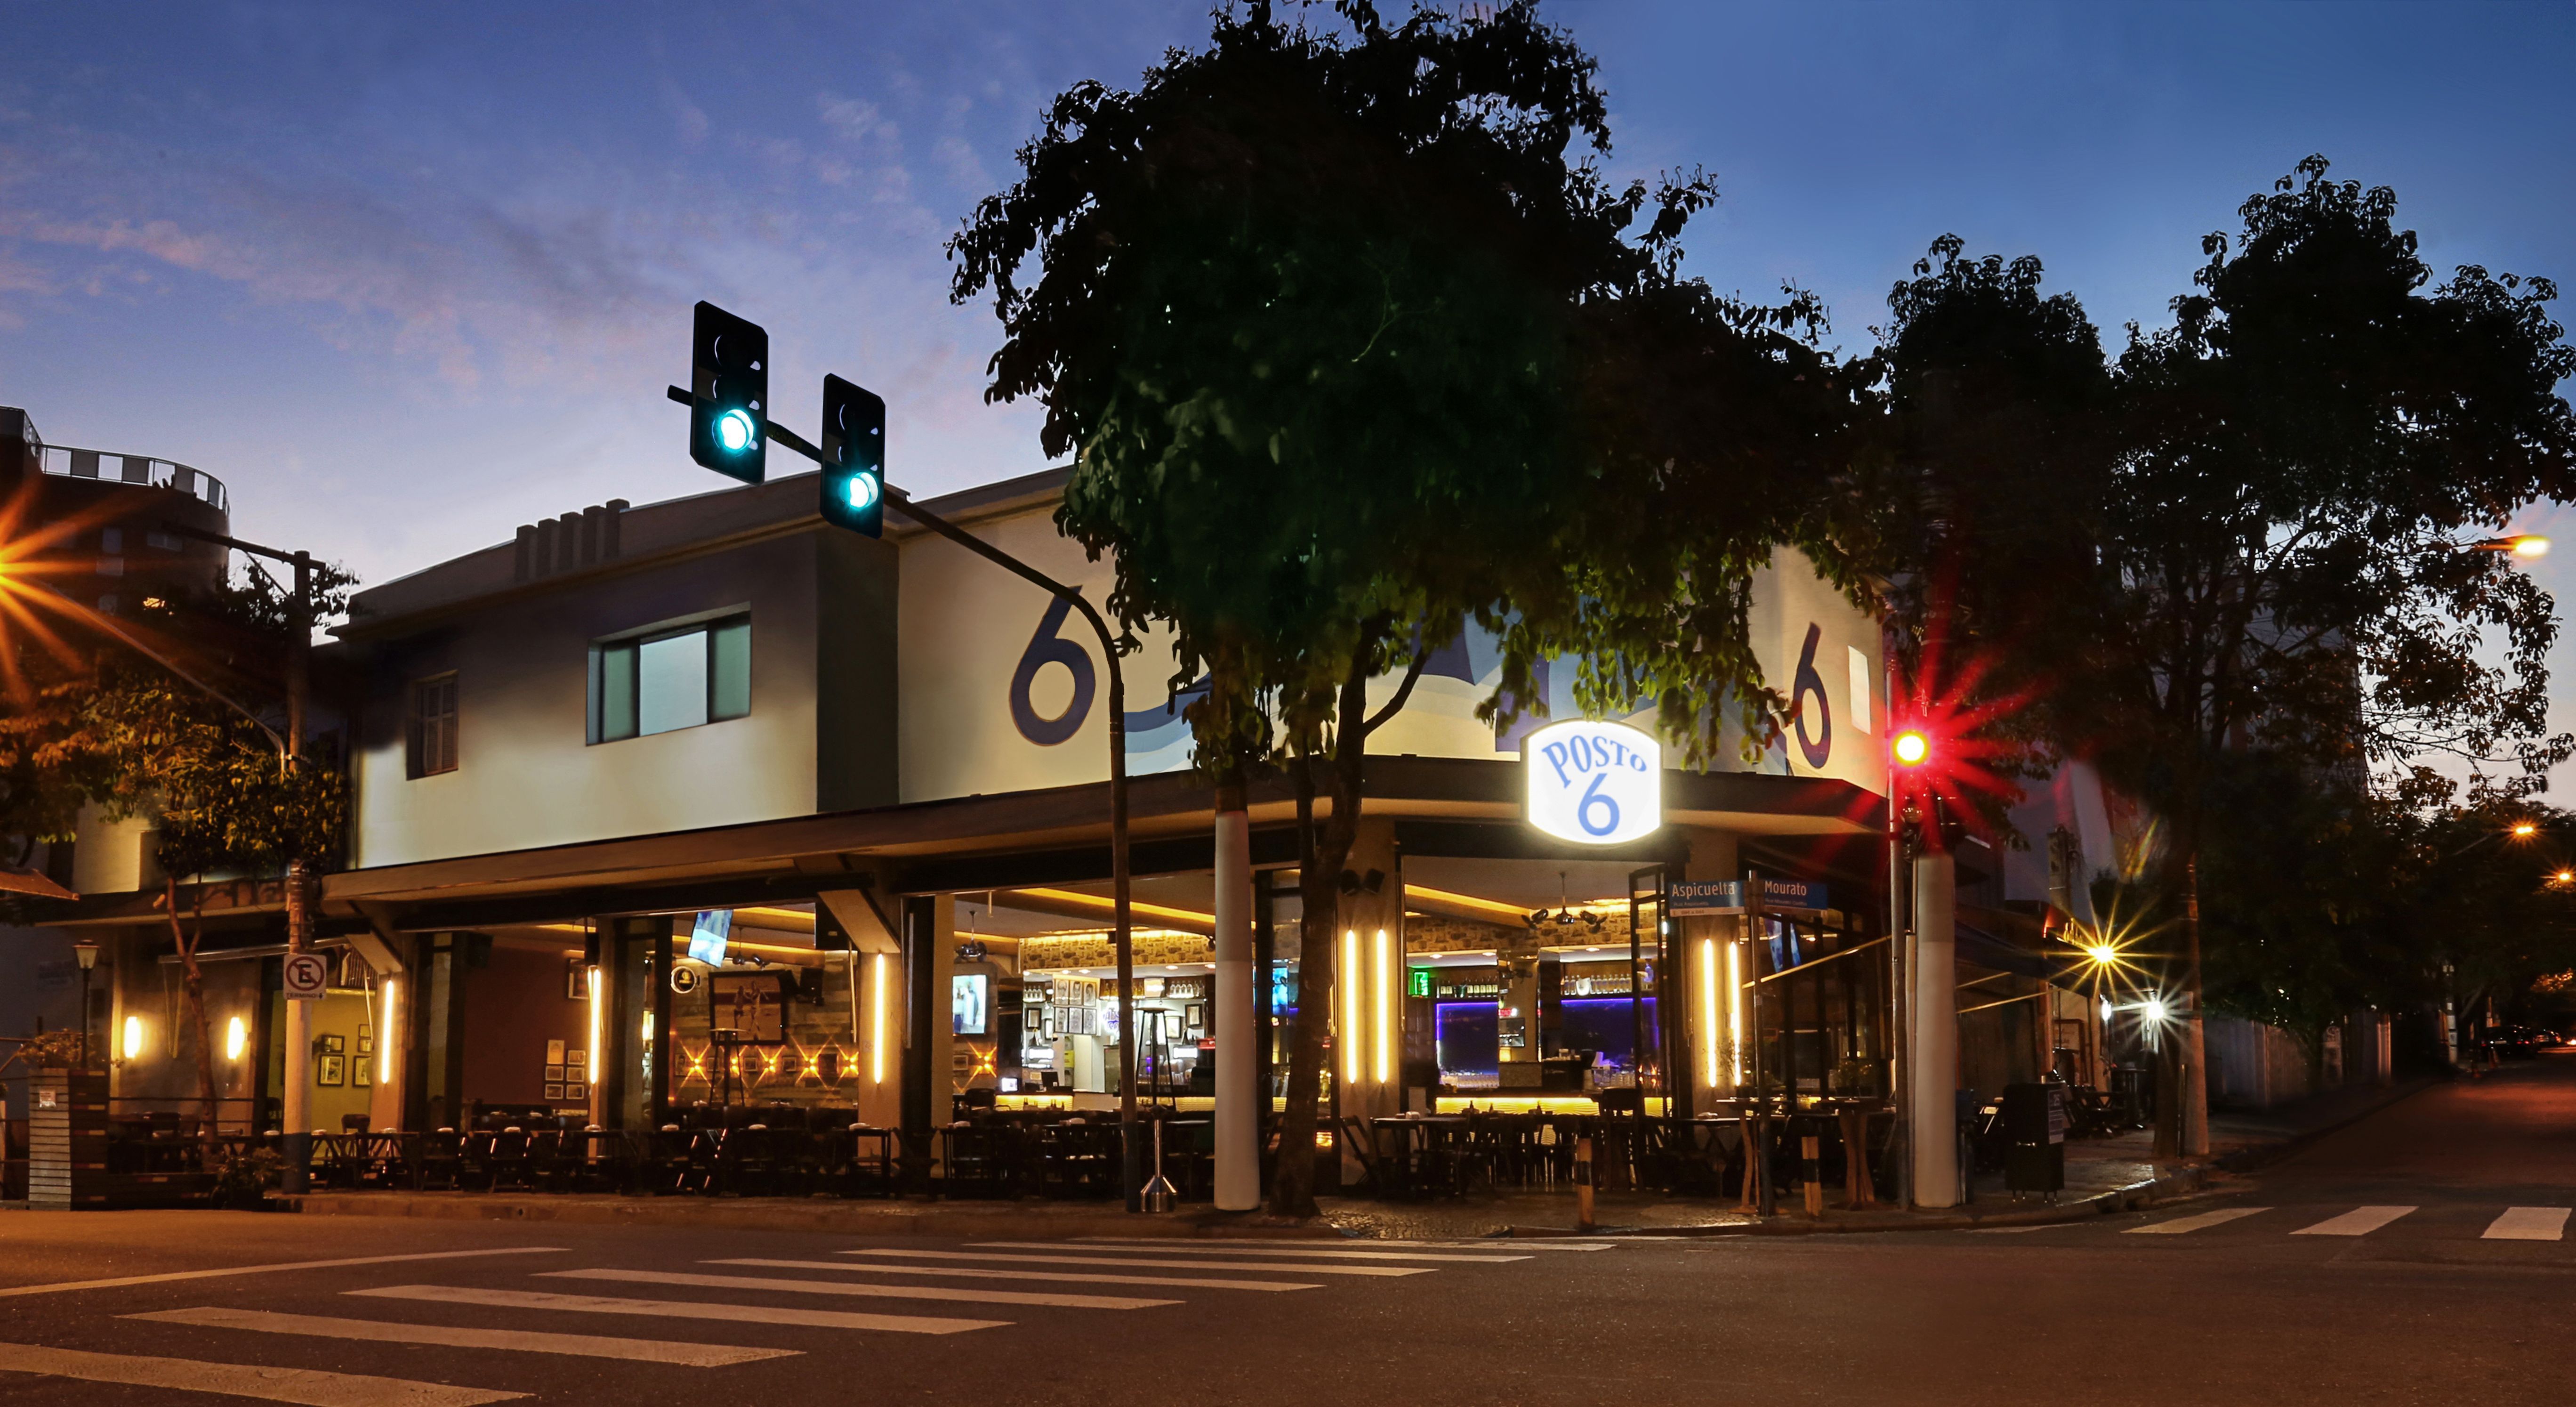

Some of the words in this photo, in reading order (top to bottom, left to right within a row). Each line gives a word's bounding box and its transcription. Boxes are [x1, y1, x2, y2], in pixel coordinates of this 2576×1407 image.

[1009, 584, 1096, 746] 6
[1792, 621, 1831, 769] 6
[1541, 735, 1647, 789] POSTO
[1578, 773, 1620, 836] 6
[1672, 882, 1735, 900] Aspicuelta
[1765, 881, 1807, 896] Mourato
